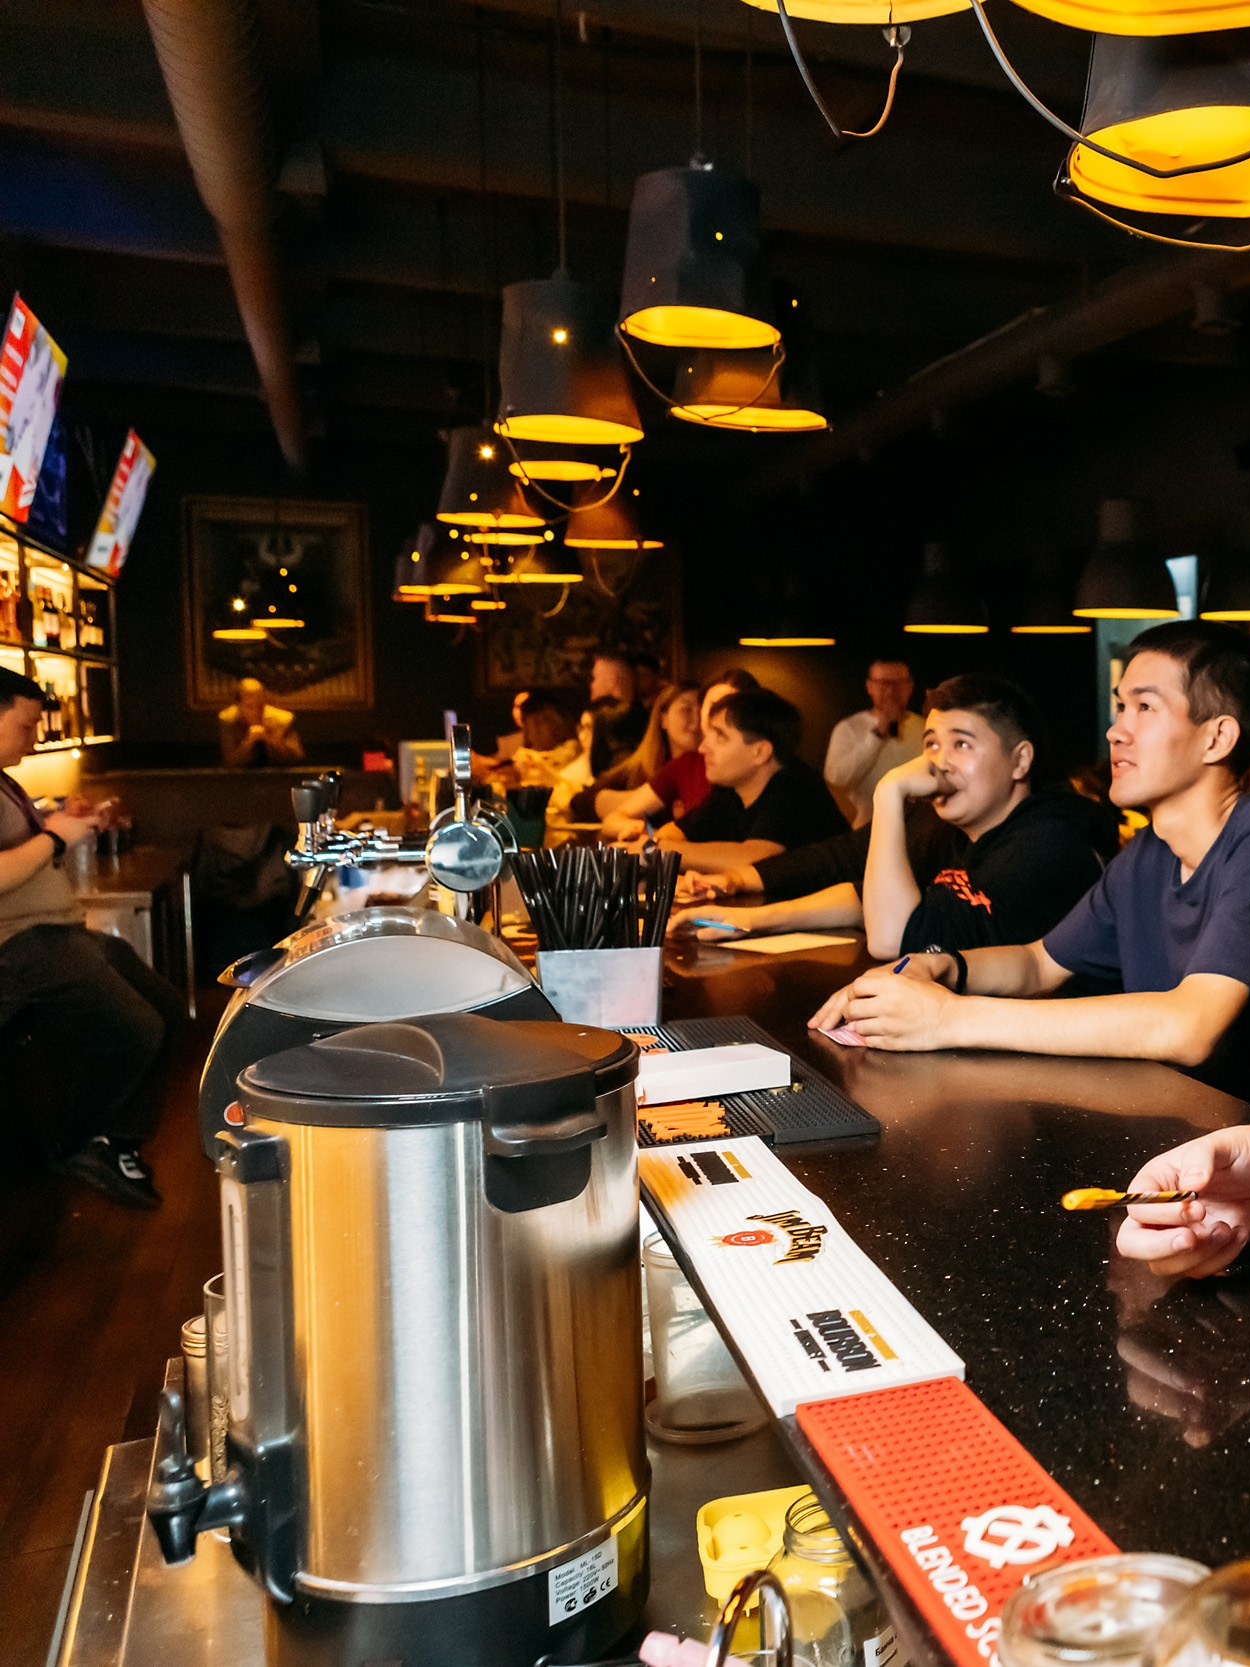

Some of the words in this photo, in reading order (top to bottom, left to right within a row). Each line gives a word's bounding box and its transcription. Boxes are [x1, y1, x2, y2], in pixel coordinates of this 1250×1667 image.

[745, 1210, 812, 1231] JIM
[772, 1225, 828, 1265] BEAM
[900, 1525, 989, 1621] BLENDED
